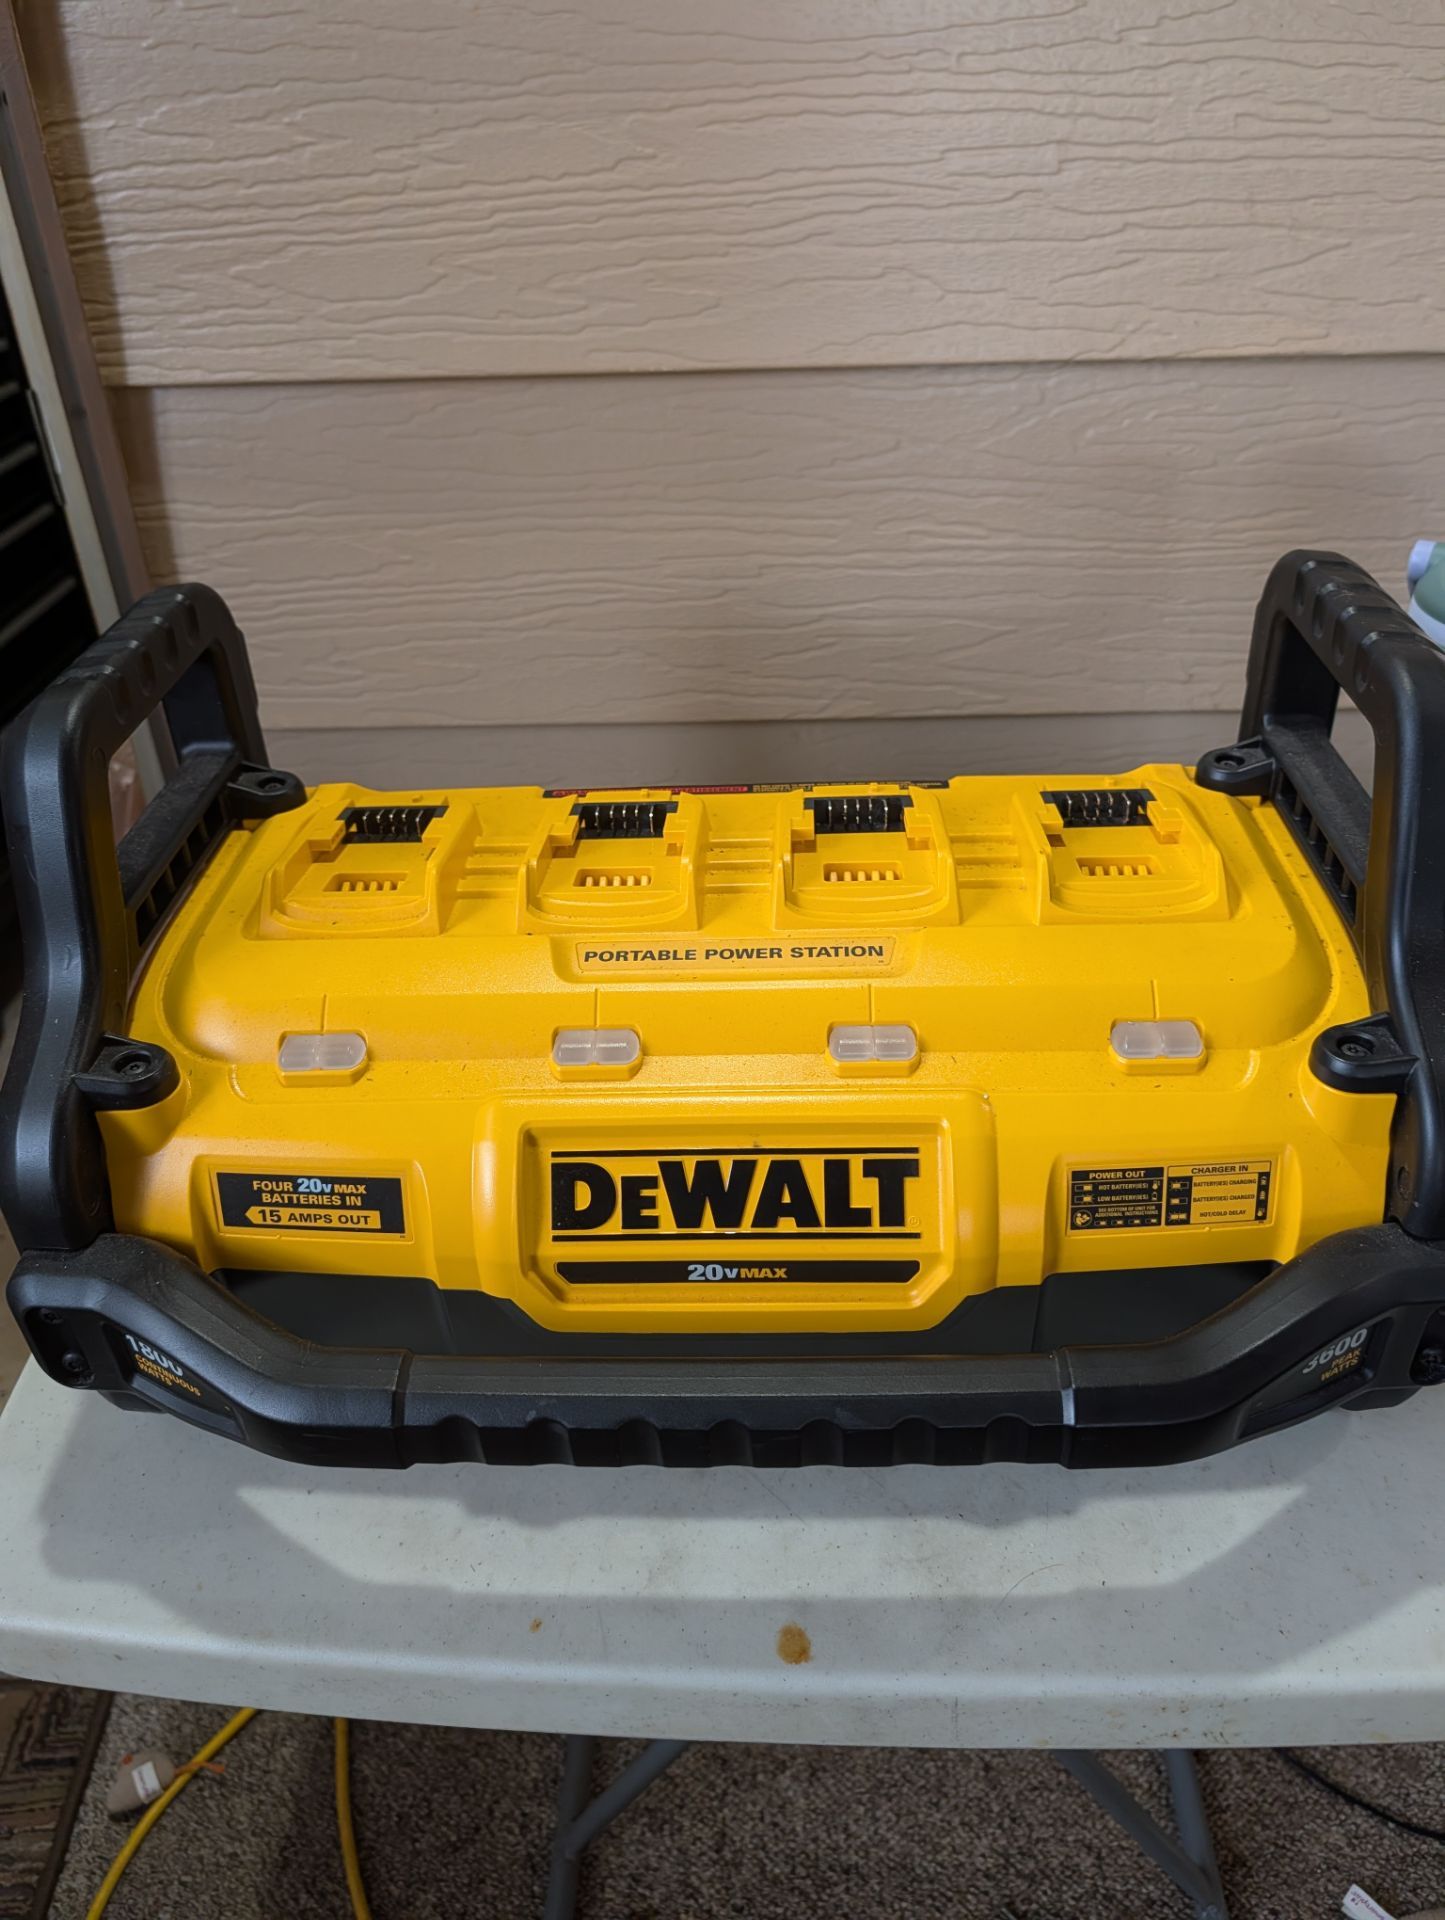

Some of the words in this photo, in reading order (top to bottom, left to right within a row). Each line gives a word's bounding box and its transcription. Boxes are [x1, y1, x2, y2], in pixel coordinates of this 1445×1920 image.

[584, 949, 697, 963] PORTABLE
[704, 947, 783, 960] POWER
[790, 945, 884, 958] STATION
[1089, 1171, 1123, 1180] POWER
[1125, 1170, 1146, 1178] OUT
[1191, 1166, 1236, 1174] CHARGER
[252, 1181, 293, 1192] FOUR
[334, 1184, 367, 1194] MAX
[262, 1193, 341, 1206] BATTERIES
[346, 1195, 362, 1206] IN
[258, 1209, 282, 1223] 15
[288, 1213, 332, 1224] AMPS
[338, 1215, 371, 1225] OUT
[1320, 1357, 1359, 1381] WATTS
